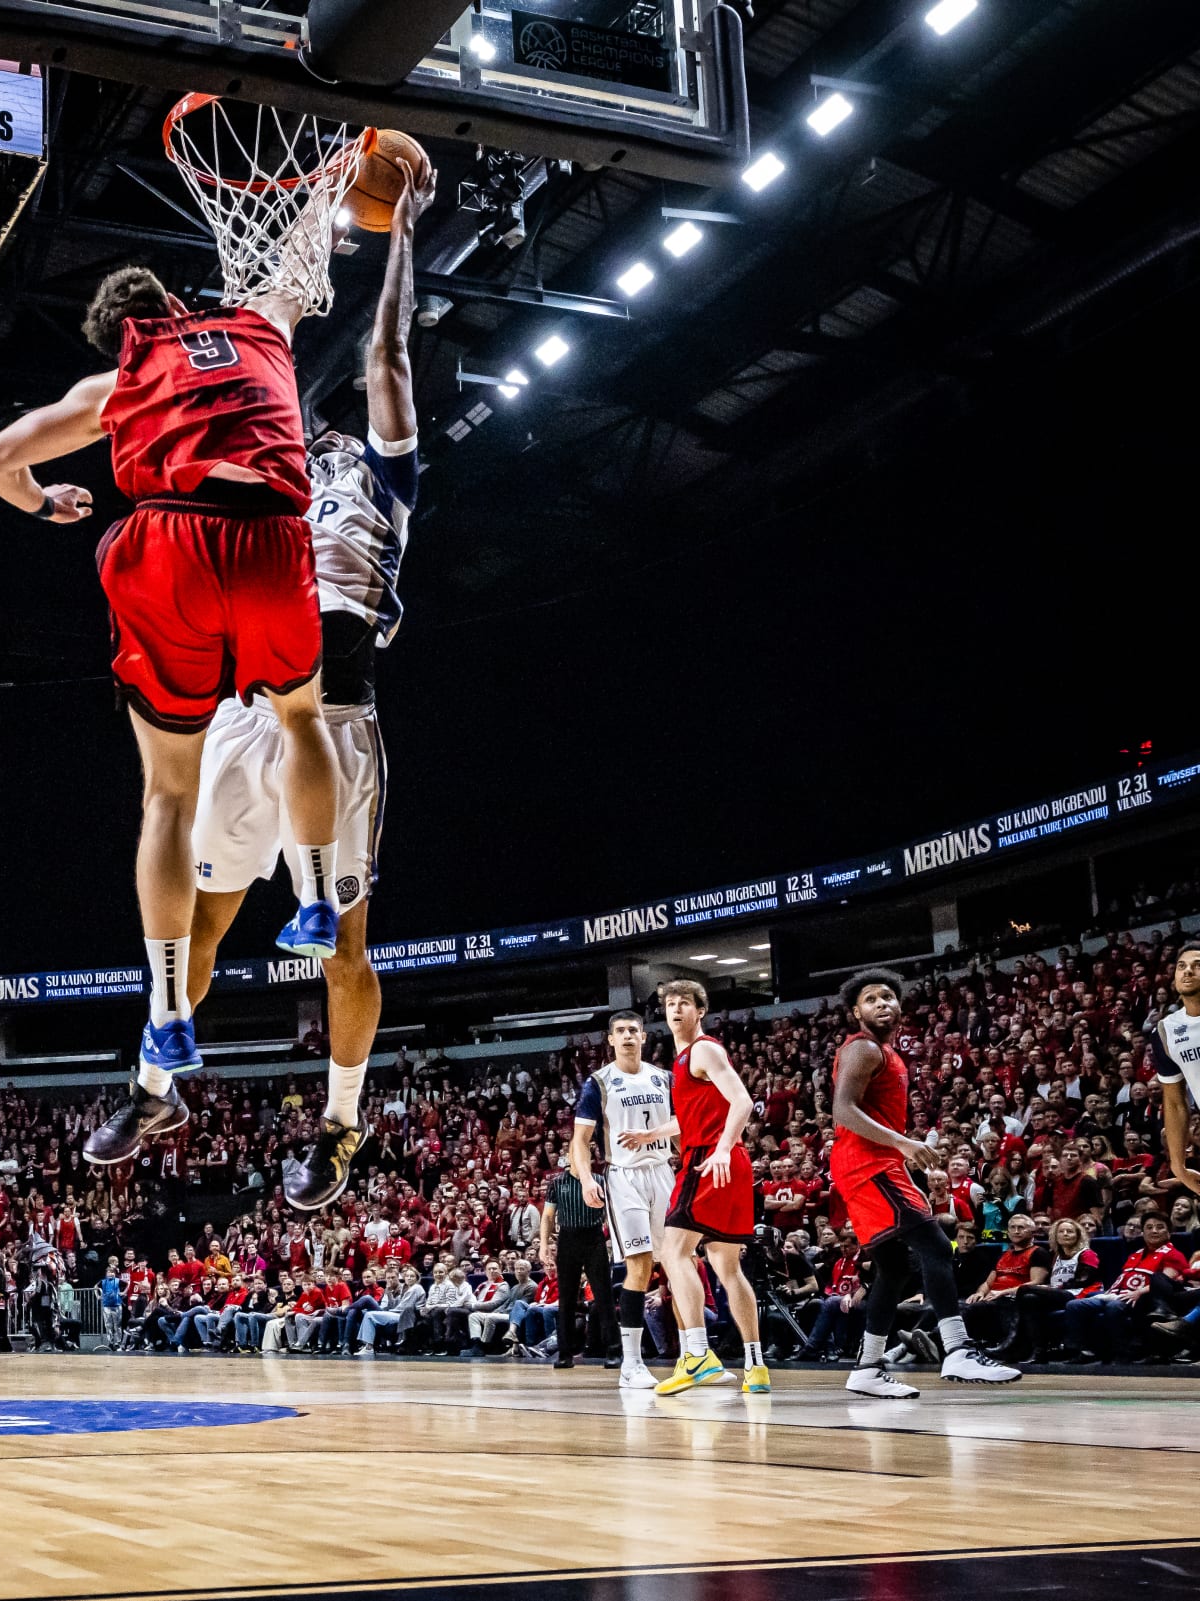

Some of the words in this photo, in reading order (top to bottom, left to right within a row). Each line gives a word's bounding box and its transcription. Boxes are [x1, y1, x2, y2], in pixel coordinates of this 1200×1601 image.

[178, 329, 239, 371] 9
[1118, 778, 1131, 797] 12
[1134, 773, 1148, 792] 31
[997, 817, 1012, 833] SU
[1014, 805, 1050, 828] KAUNO
[1051, 785, 1107, 816] BIGBENDU
[1117, 790, 1152, 812] VILNIUS
[903, 823, 992, 876] MERŪNAS
[787, 877, 800, 892] 12
[801, 873, 814, 889] 31
[674, 900, 688, 914] SU
[690, 892, 723, 910] KAUNO
[726, 881, 777, 903] BIGBENDU
[785, 888, 818, 904] VILNIUS
[583, 903, 669, 944] MERŪNAS
[374, 943, 406, 961] KAUNO
[408, 939, 456, 958] BIGBENDU
[466, 937, 478, 950] 12
[479, 934, 491, 947] 31
[464, 948, 494, 960] VILNIUS
[46, 975, 59, 987] SU
[61, 973, 93, 986] KAUNO
[95, 970, 142, 983] BIGBENDU
[620, 1093, 663, 1108] HEIDELBERG
[642, 1111, 650, 1130] 7
